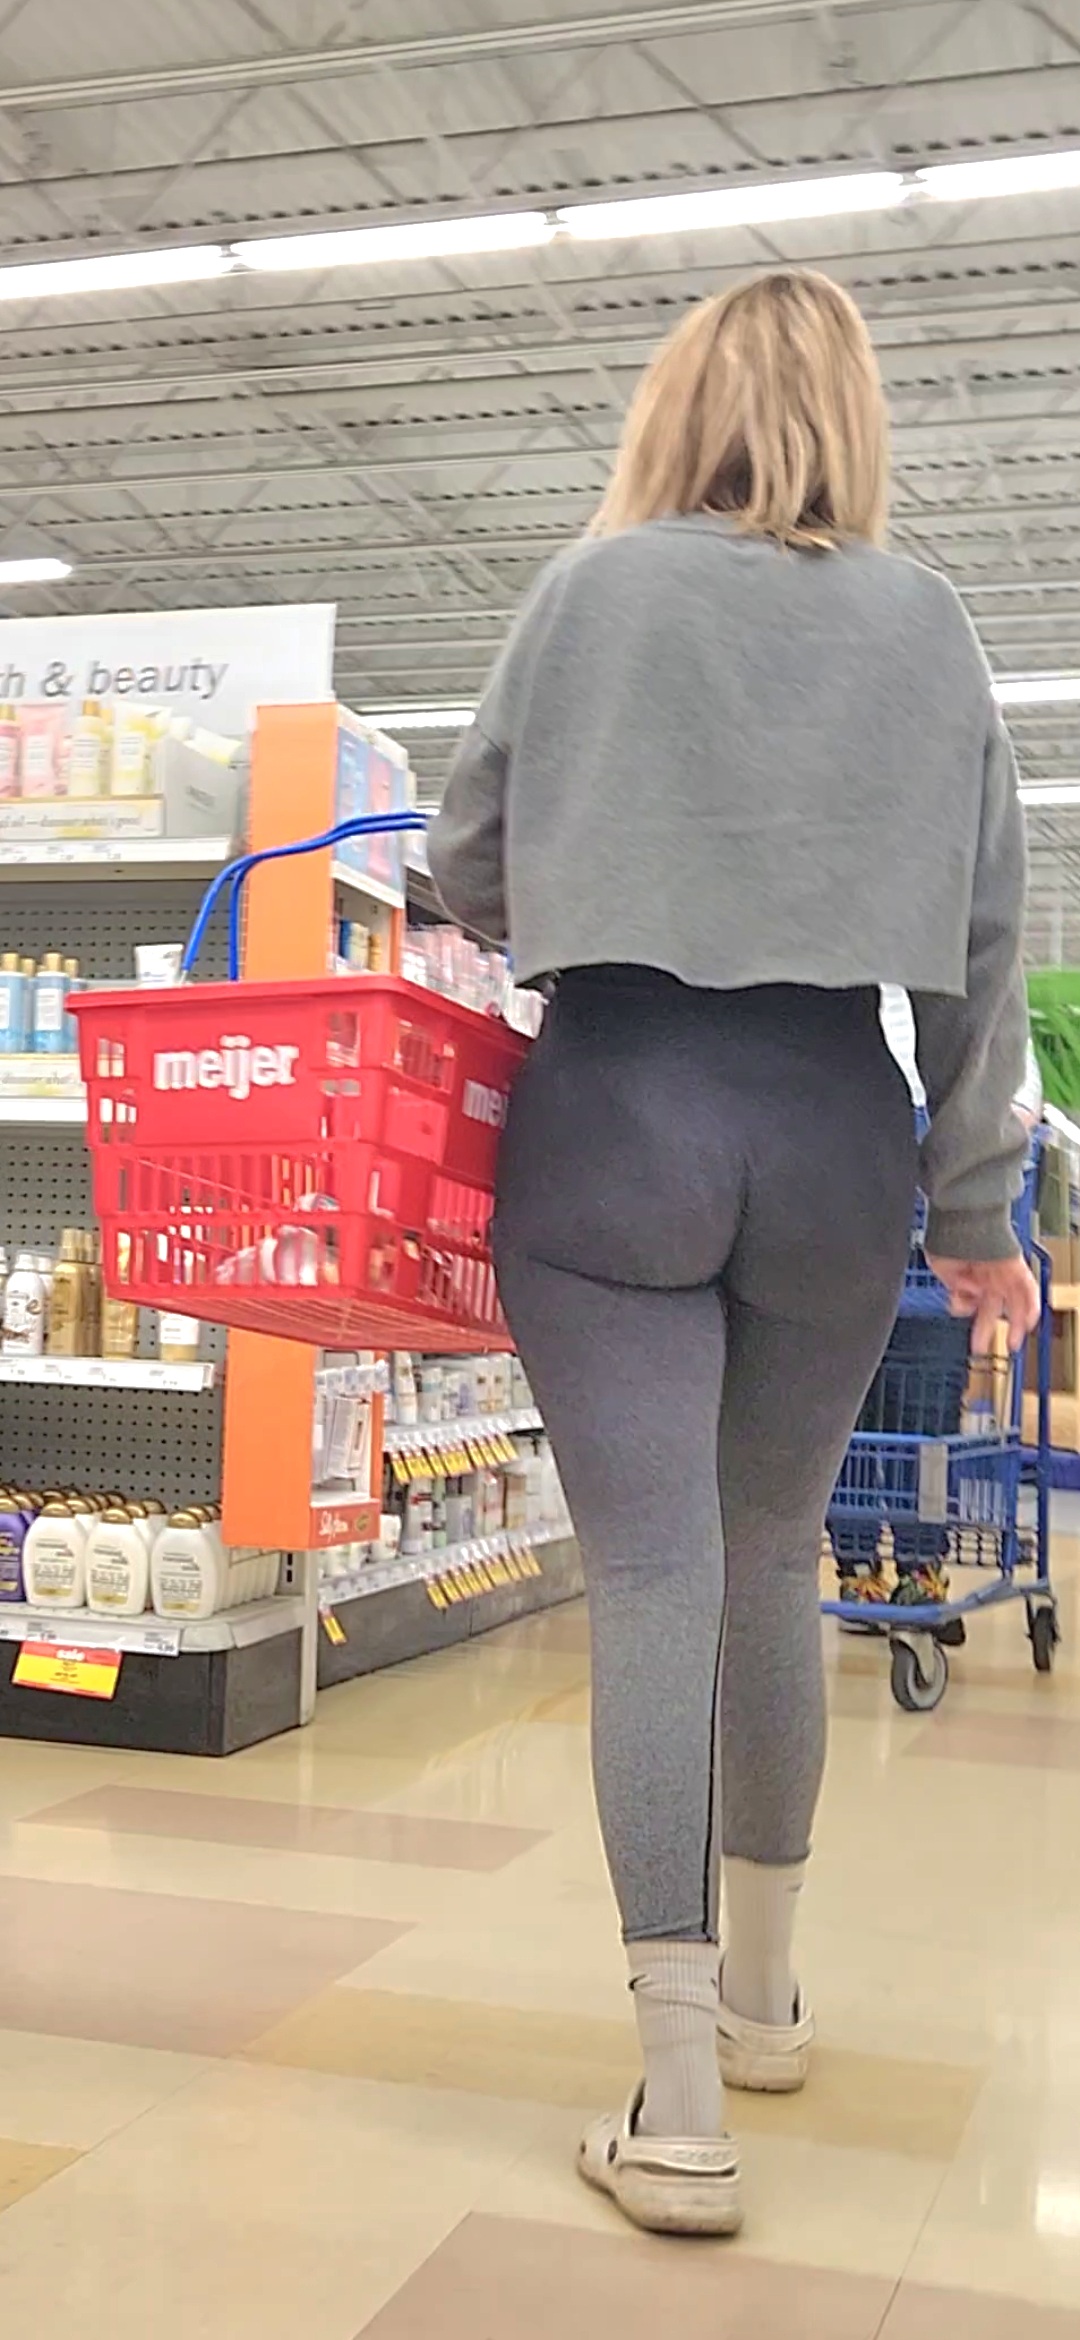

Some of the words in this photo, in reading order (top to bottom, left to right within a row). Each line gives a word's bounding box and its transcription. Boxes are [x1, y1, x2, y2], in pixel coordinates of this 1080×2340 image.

[42, 661, 75, 697] &
[87, 657, 229, 700] beauty
[153, 1034, 300, 1100] meijer
